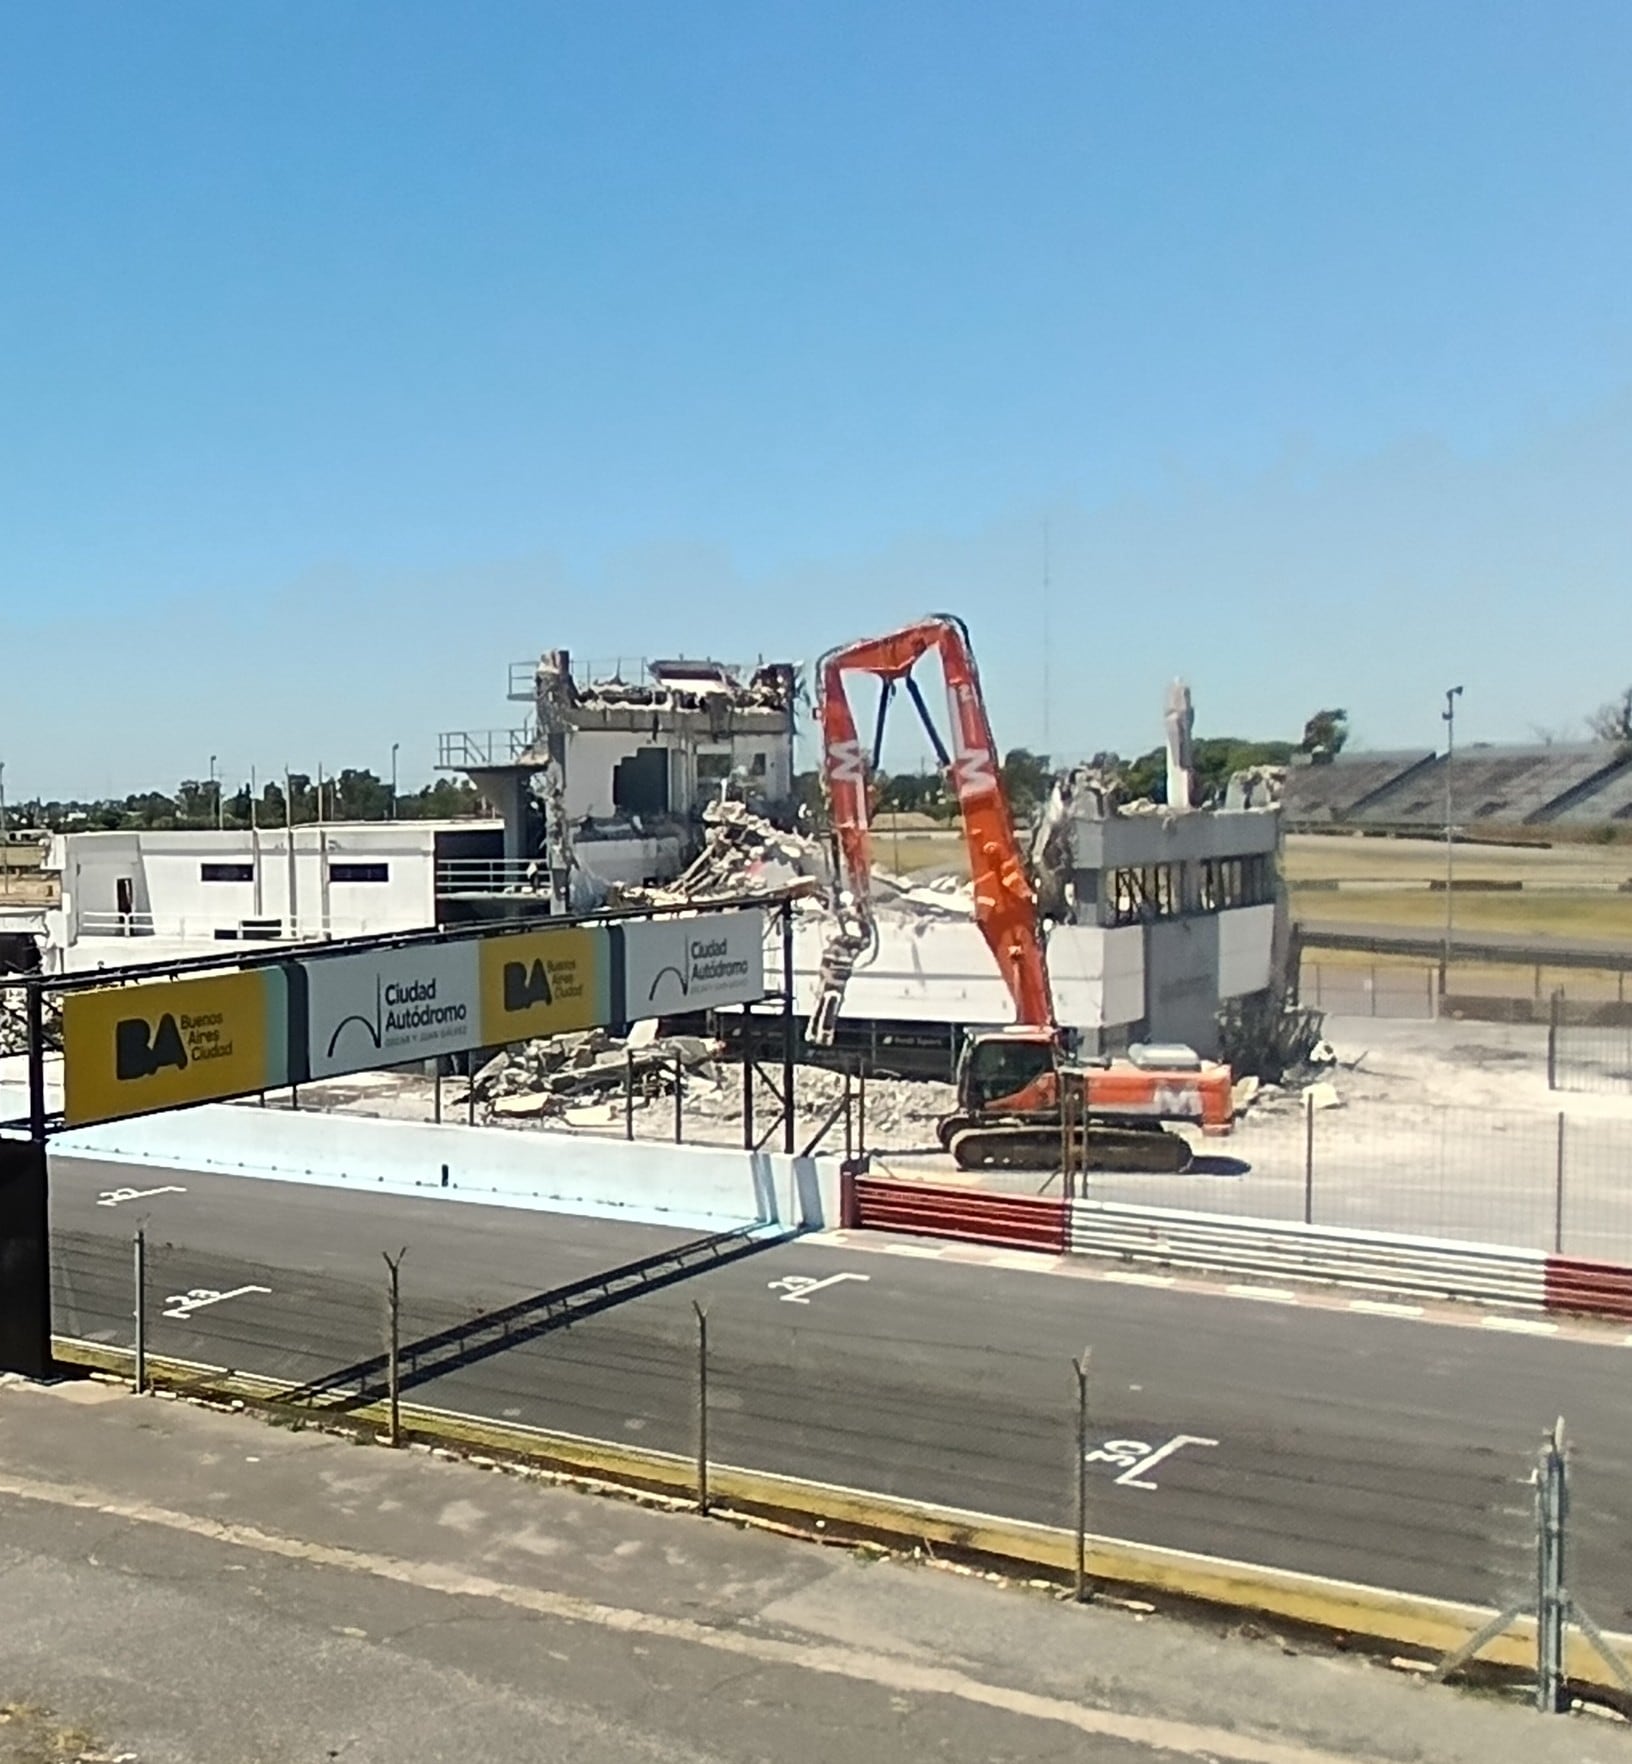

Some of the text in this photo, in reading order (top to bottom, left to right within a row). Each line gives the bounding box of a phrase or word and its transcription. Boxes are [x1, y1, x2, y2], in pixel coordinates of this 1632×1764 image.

[691, 938, 727, 960] Ciudad
[691, 960, 748, 982] Autódromo
[385, 978, 436, 1006] Ciudad
[503, 958, 552, 1012] BA
[180, 1012, 223, 1030] Buenos
[385, 1004, 467, 1032] Autódromo
[116, 1012, 188, 1081] BA
[188, 1029, 220, 1046] Aires
[192, 1040, 233, 1062] Ciudad
